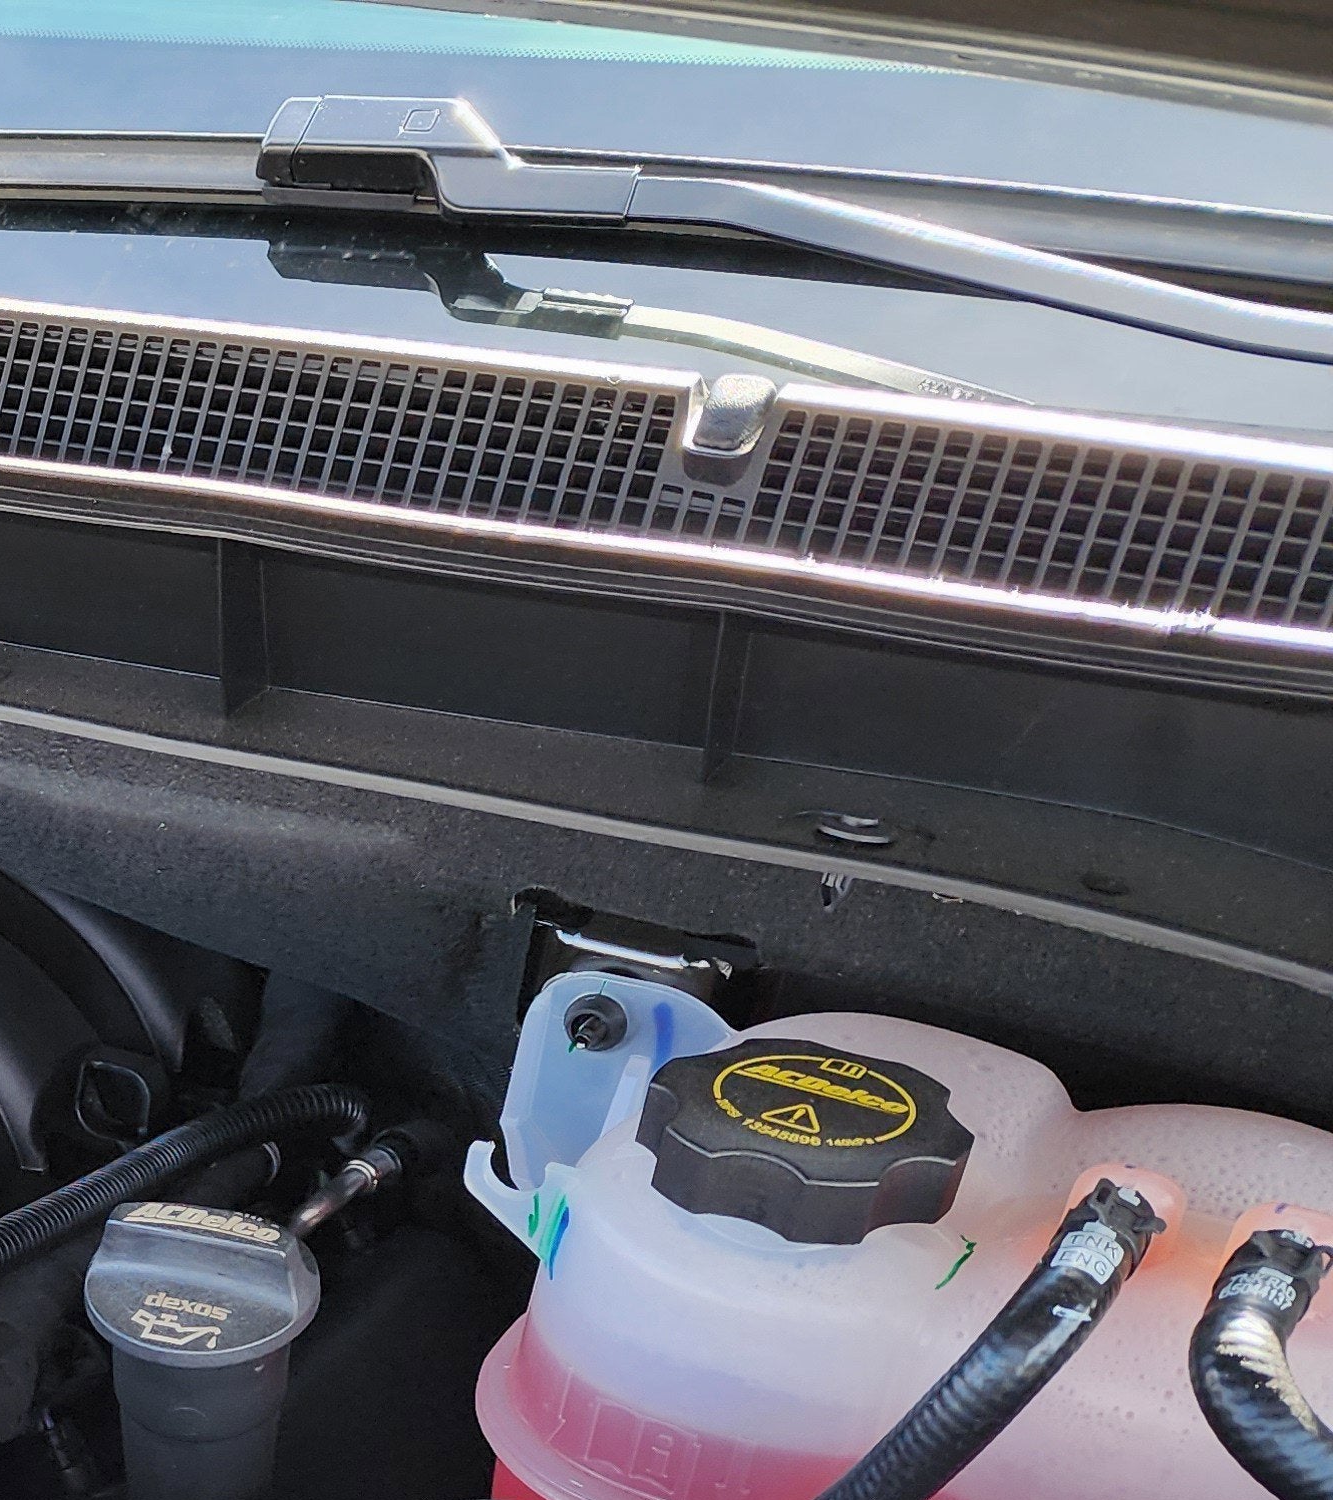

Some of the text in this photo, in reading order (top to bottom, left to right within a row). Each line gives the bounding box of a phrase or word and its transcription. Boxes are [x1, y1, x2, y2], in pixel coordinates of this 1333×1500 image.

[744, 1064, 909, 1114] ACDelco
[127, 1202, 281, 1242] ACDelco
[1070, 1234, 1118, 1260] TNK
[1059, 1250, 1108, 1277] ENG
[144, 1292, 232, 1321] dexos
